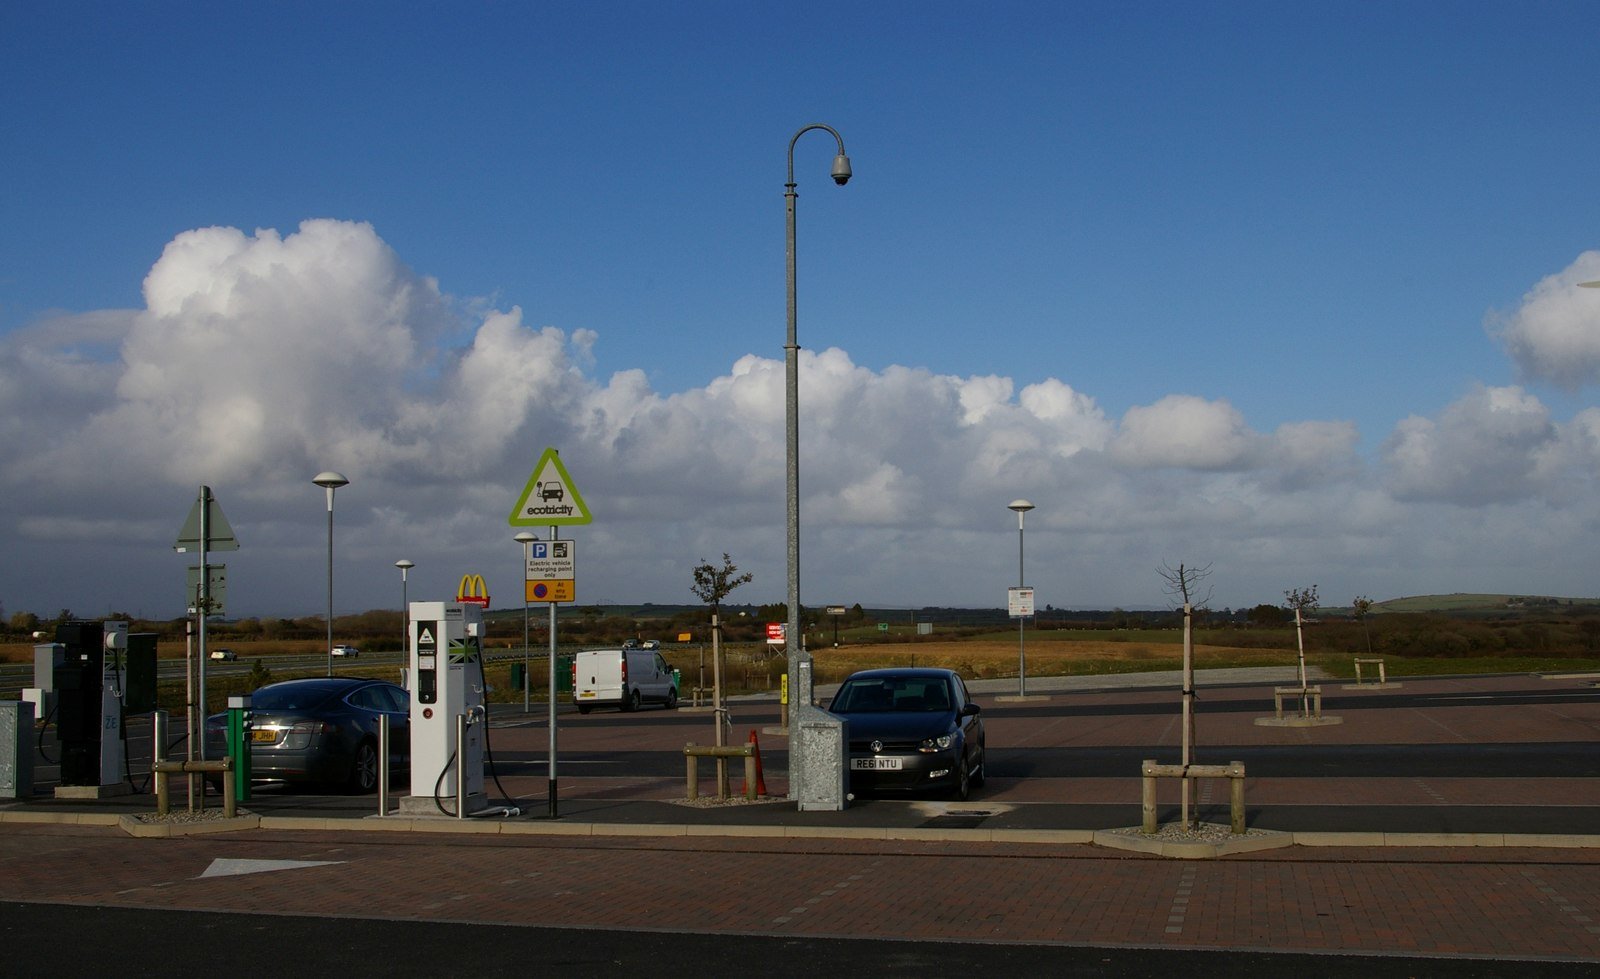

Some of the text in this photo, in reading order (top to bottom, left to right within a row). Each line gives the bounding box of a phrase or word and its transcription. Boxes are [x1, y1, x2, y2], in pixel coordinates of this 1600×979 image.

[527, 505, 573, 516] ecotricity
[536, 545, 545, 557] P
[856, 759, 897, 769] RE61 NTU
